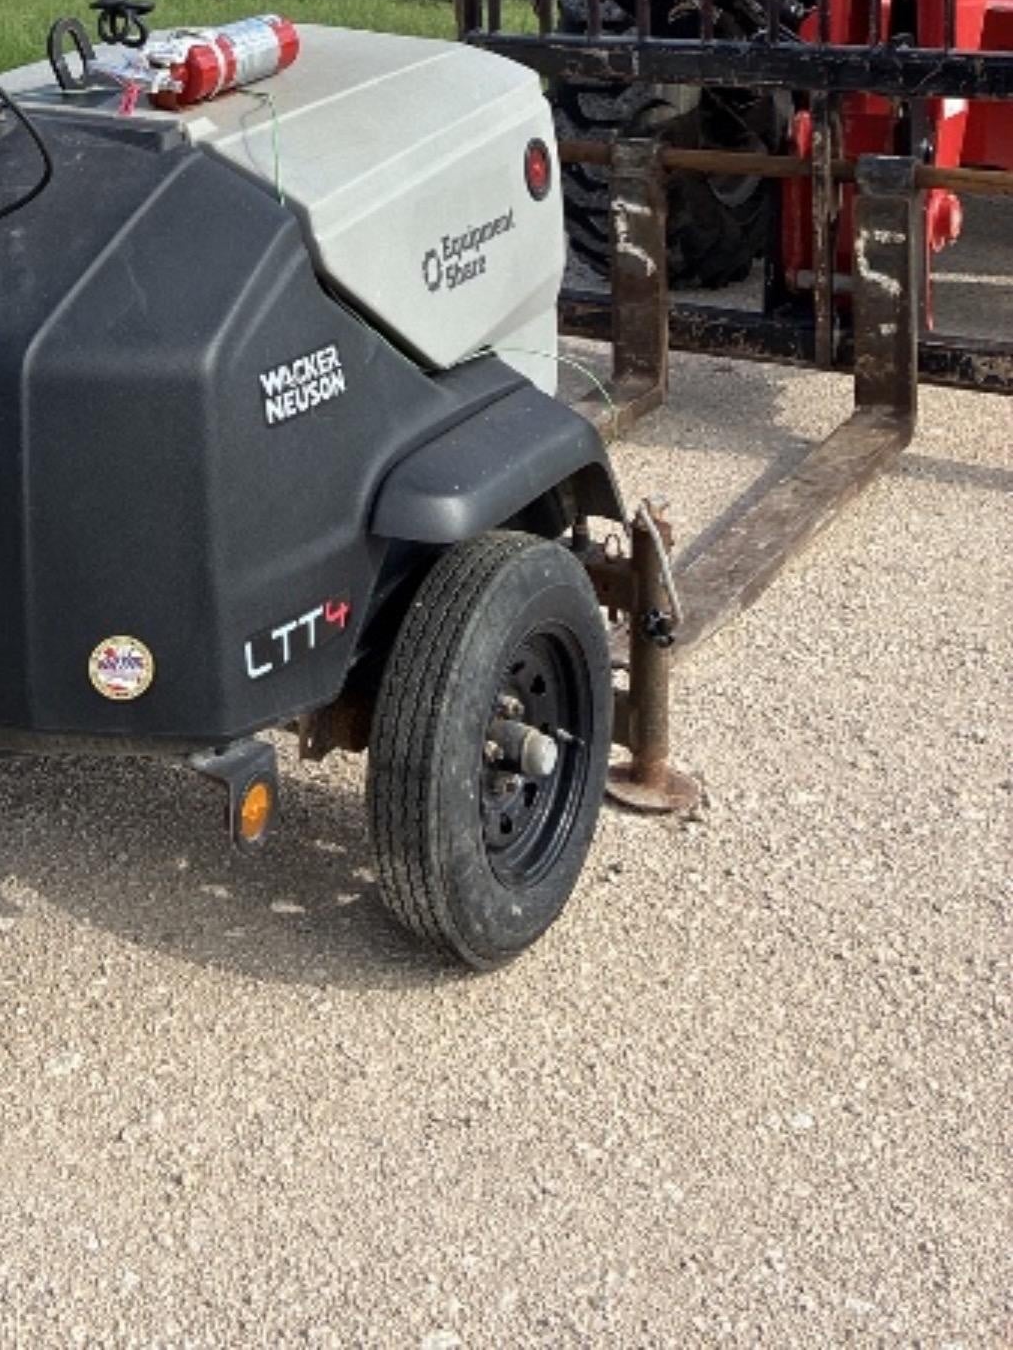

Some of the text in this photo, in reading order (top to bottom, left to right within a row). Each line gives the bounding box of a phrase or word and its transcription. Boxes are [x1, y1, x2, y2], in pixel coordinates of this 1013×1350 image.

[259, 344, 343, 397] WACKER
[265, 368, 346, 425] NEUSON
[244, 601, 350, 680] LTT4
